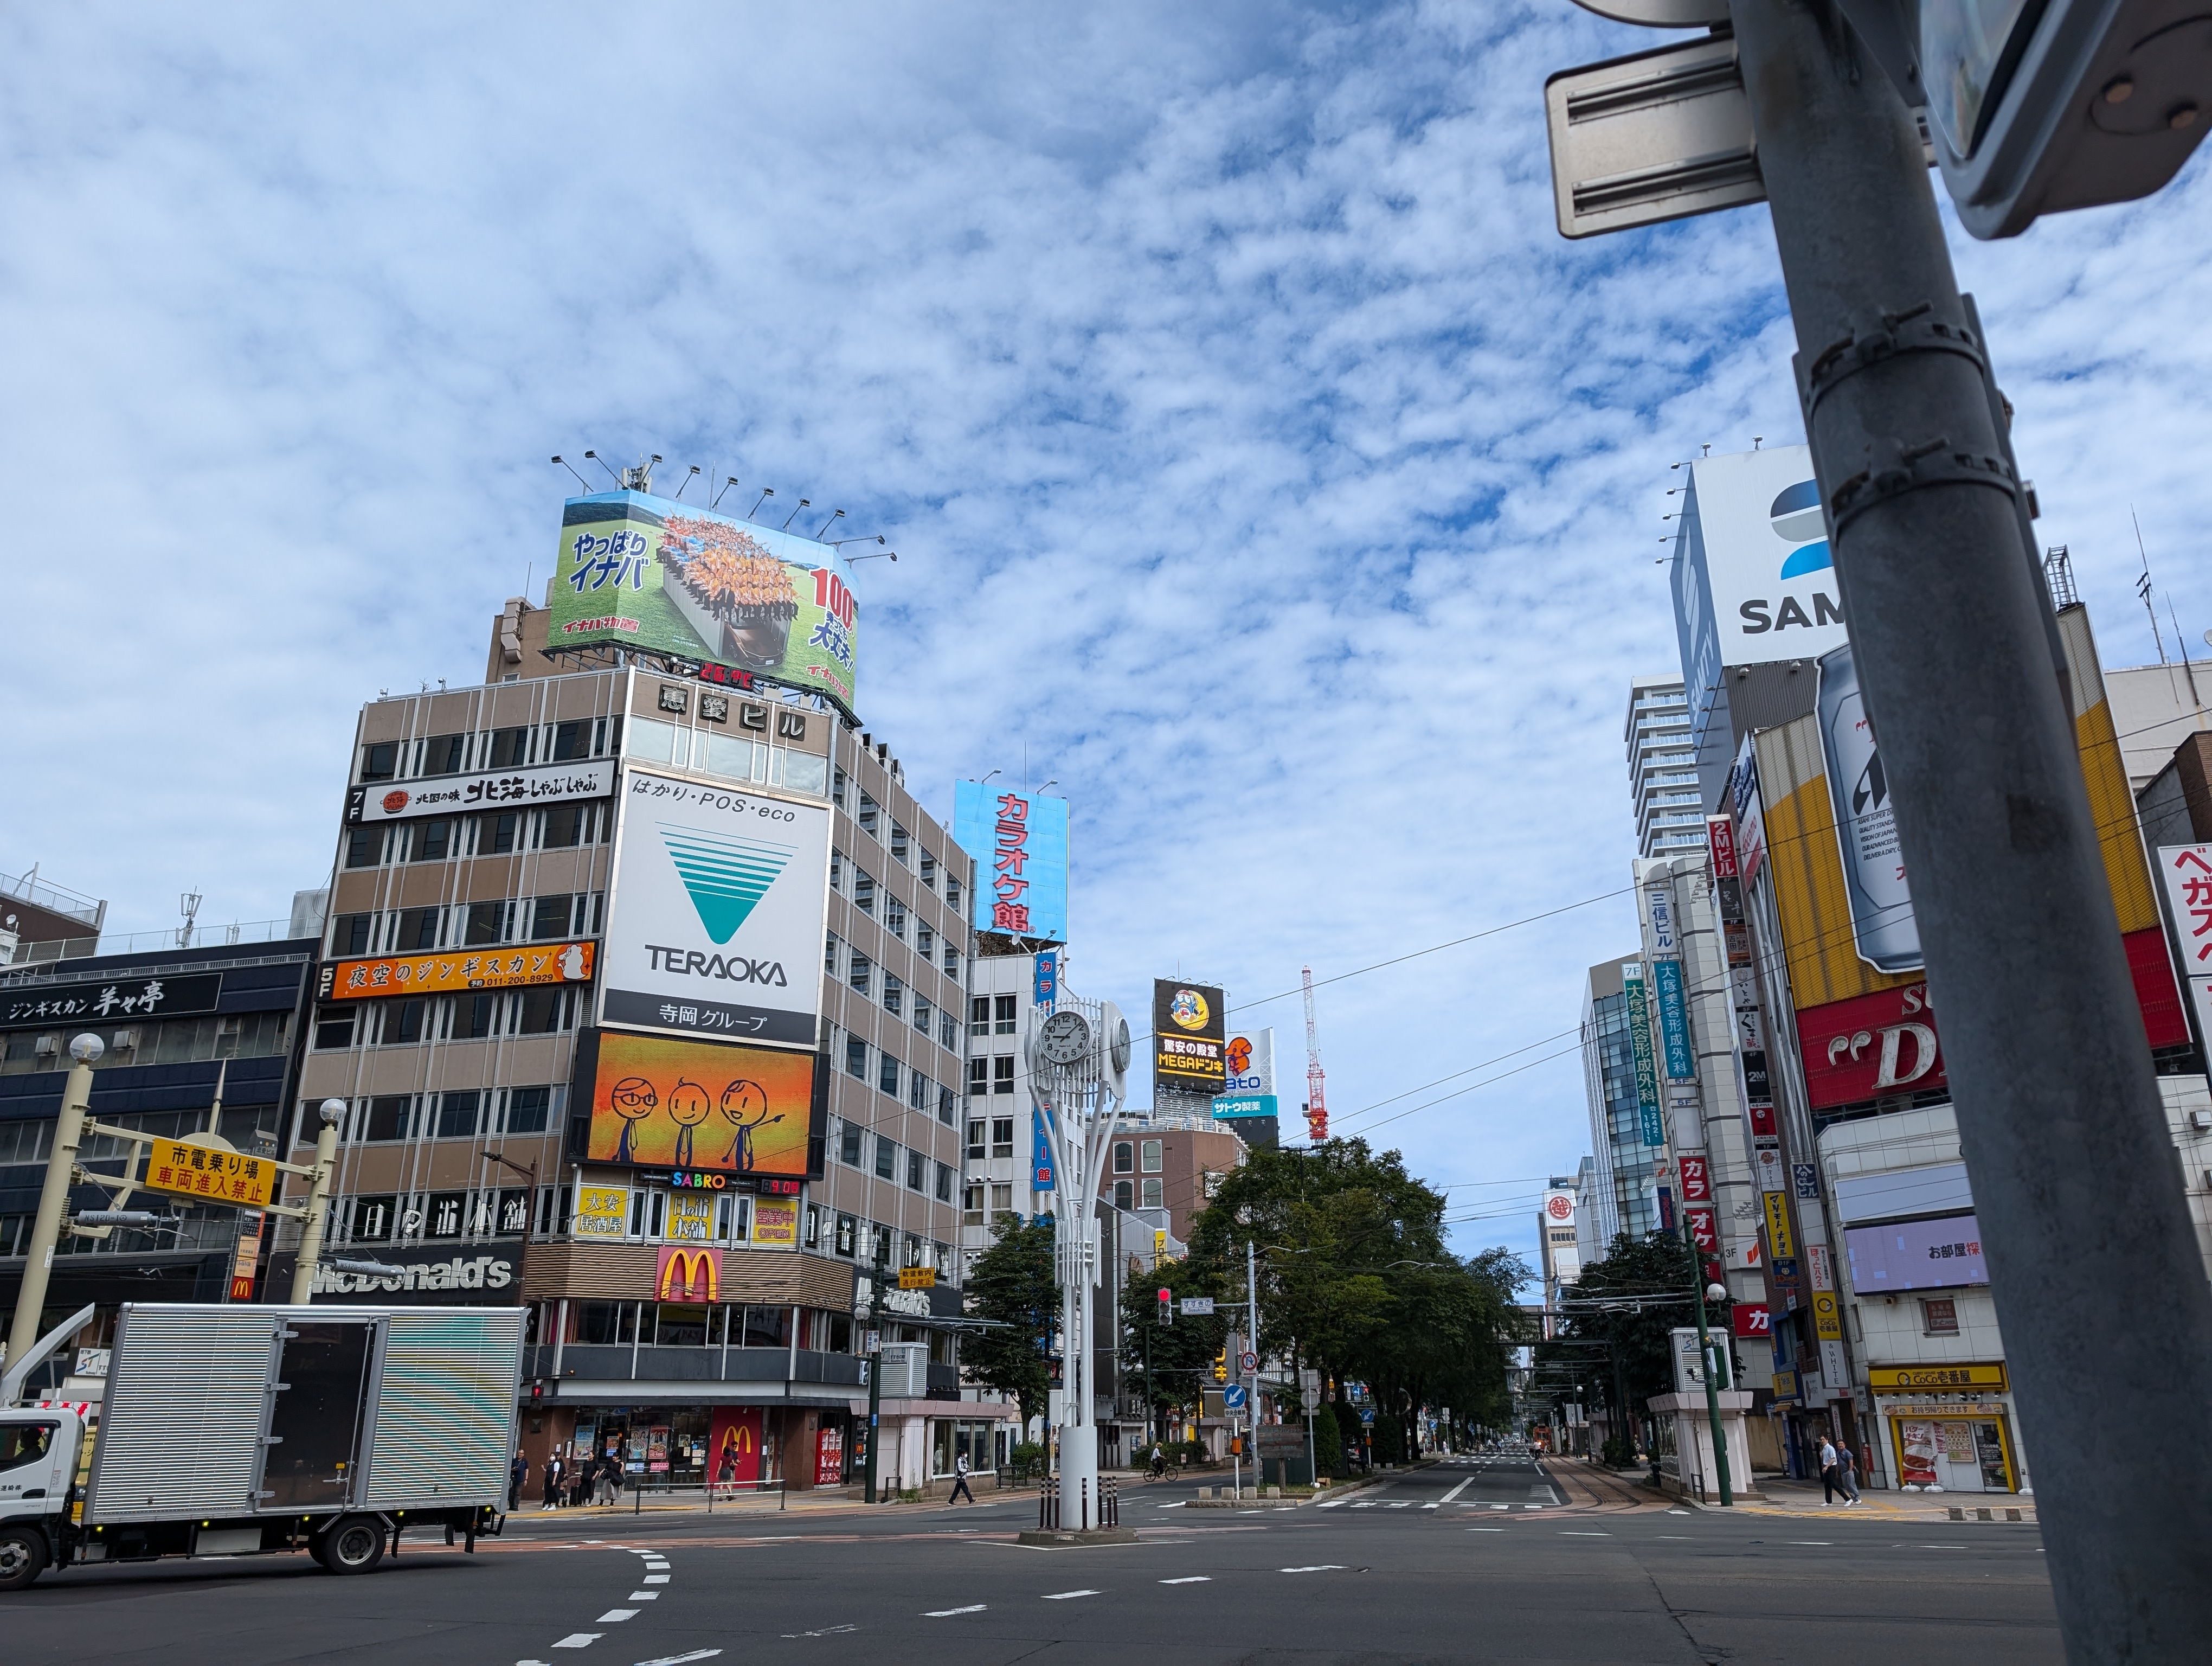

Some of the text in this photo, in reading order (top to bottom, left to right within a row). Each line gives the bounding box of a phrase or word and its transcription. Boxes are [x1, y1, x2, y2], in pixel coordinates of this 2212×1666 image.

[573, 530, 649, 563] やっぱり
[569, 555, 651, 593] イナバ
[562, 617, 640, 635] イナバ物置
[1692, 619, 1714, 726] SAMTY
[1857, 816, 1870, 825] ASAHI
[1870, 812, 1886, 821] SUPER
[1859, 823, 1876, 834] QUALITY
[1714, 823, 1734, 875] 2Mビル
[993, 793, 1029, 933] カラオケ館
[1651, 893, 1673, 948] 三信ビル
[347, 954, 548, 989] 夜空のジンギスカン
[645, 944, 788, 988] TERAOKA
[1624, 966, 1641, 977] 7F
[471, 973, 554, 988] 予約 011-200-8929
[1739, 983, 1751, 1004] いとや
[9, 997, 88, 1021] ジンギスカン
[1660, 965, 1688, 1074] 大塚美容形成外科
[1164, 1039, 1218, 1058] 驚安の殿堂
[1626, 984, 1656, 1104] 大塚美容形成外科
[1159, 1053, 1224, 1073] MEGAドンキ
[1748, 1071, 1766, 1082] 2M
[1214, 1101, 1261, 1113] サトウ製薬
[172, 1146, 259, 1180] 市電乗り場
[156, 1165, 263, 1203] 車両進入禁止
[672, 1172, 726, 1189] SABRO
[586, 1193, 620, 1212] 大安
[1663, 1197, 1673, 1229] PROMISE
[578, 1216, 623, 1235] 居酒屋
[756, 1208, 795, 1226] 営業中
[1770, 1194, 1787, 1256] マツモトキヨシ
[758, 1229, 791, 1240] OPEN
[1726, 1247, 1737, 1258] 3F
[1810, 1248, 1823, 1289] ほっとハウス
[1750, 1310, 1770, 1330] カ
[1829, 1351, 1840, 1385] WHITE
